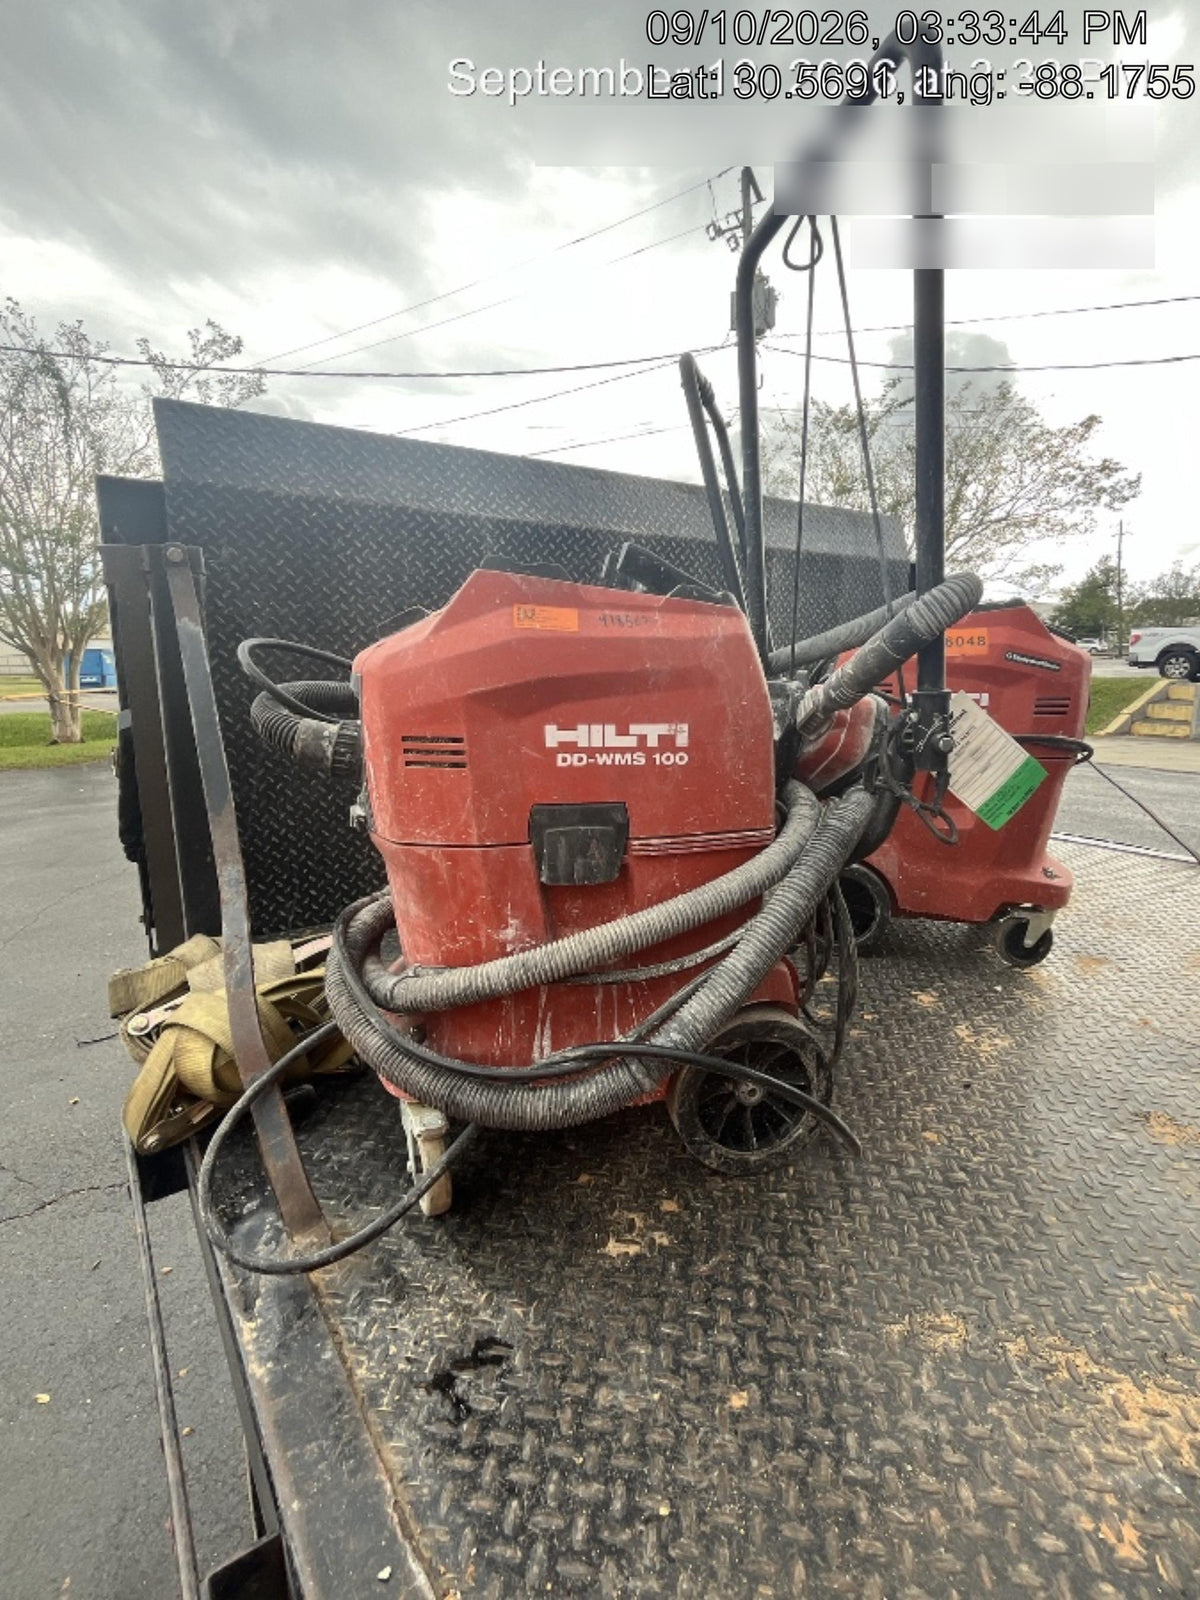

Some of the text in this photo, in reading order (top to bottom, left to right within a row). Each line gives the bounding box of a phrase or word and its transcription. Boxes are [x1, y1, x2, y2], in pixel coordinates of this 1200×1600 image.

[544, 723, 689, 748] HILTI
[556, 752, 689, 767] DD-WMS 100
